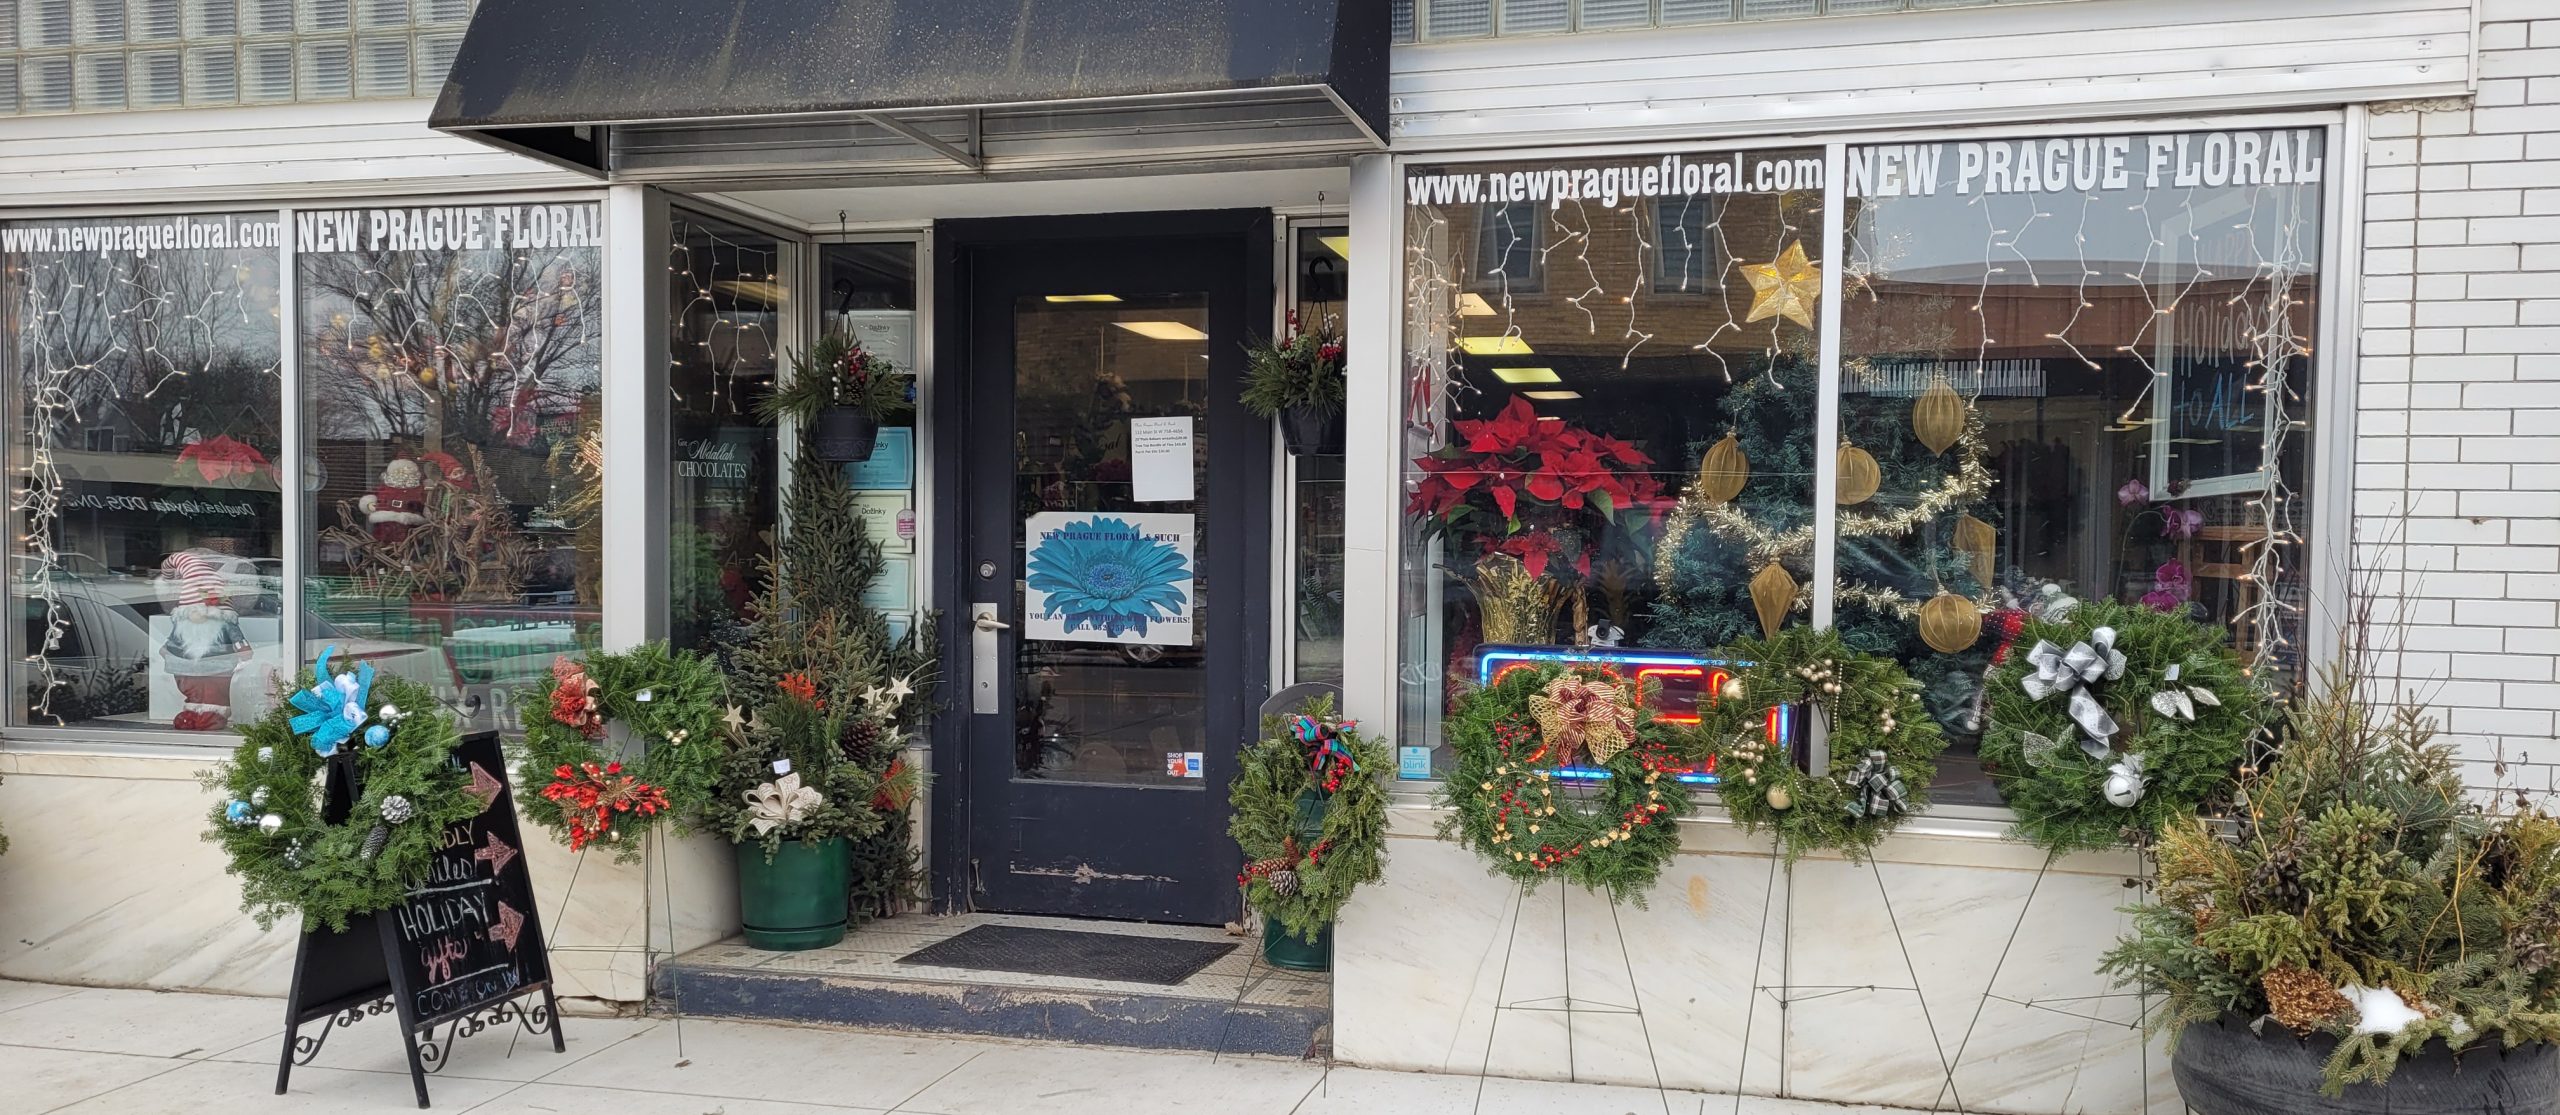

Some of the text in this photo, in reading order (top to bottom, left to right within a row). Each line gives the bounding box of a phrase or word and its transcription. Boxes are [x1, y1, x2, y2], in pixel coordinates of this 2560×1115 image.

[1408, 152, 1824, 209] www.newpraguefloral.com
[1846, 130, 2321, 198] NEW PRAGUE FLORAL
[1, 215, 280, 258] www.newpraguefloral.com
[297, 204, 602, 253] NEW PRAGUE FLORAL
[2174, 372, 2255, 438] to ALL
[678, 461, 747, 479] CHOCOLATES
[688, 438, 737, 461] Abdallah
[1040, 531, 1180, 542] NEW PRAGUE FLORAL & SUCH
[1029, 612, 1047, 620] YOU
[1150, 616, 1191, 624] FLOWERS!
[1403, 760, 1425, 769] blink
[398, 892, 489, 941] HOLIDAY
[421, 936, 468, 984] gifts
